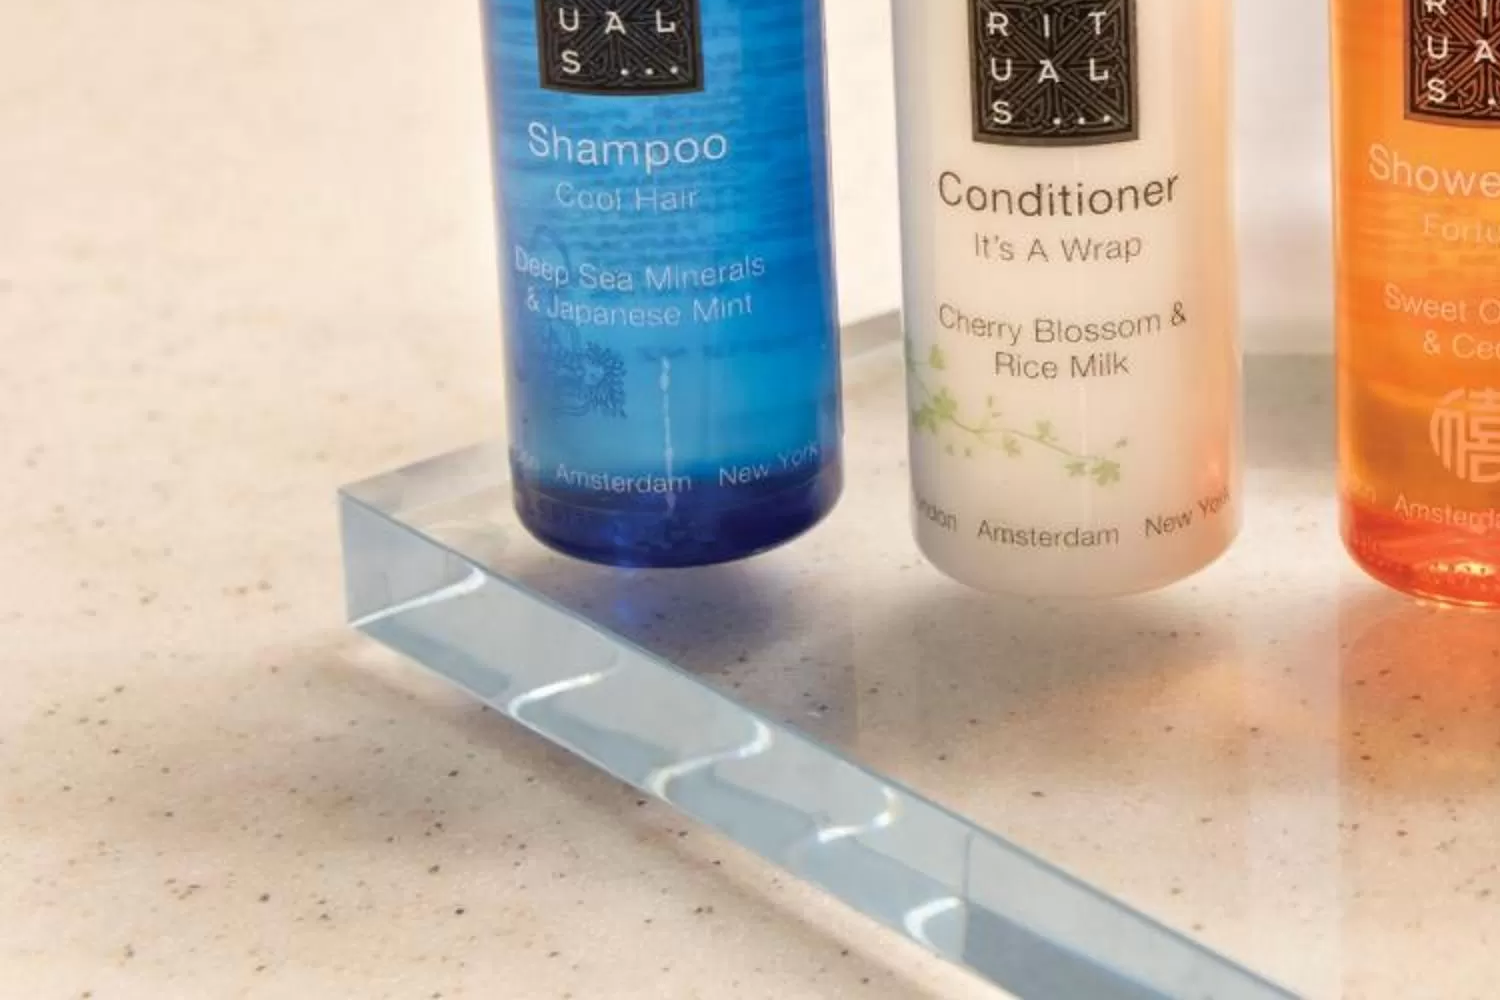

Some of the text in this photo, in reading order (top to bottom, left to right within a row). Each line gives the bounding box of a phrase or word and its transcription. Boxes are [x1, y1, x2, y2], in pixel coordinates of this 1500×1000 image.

[526, 120, 728, 174] Shampoo
[635, 186, 697, 213] Hair
[938, 170, 1179, 218] Conditioner
[514, 244, 766, 292] Deep Sea Minerals
[974, 231, 1142, 265] It's A Wrap
[525, 286, 753, 328] & Japanese Mint
[938, 300, 1187, 347] Cherry Blossom &
[1383, 282, 1468, 324] Sweet
[1421, 329, 1442, 356] &
[994, 350, 1132, 380] Rice Milk
[555, 462, 692, 494] Amsterdam
[718, 462, 770, 487] New
[976, 518, 1120, 549] Amsterdam
[1144, 509, 1193, 538] New
